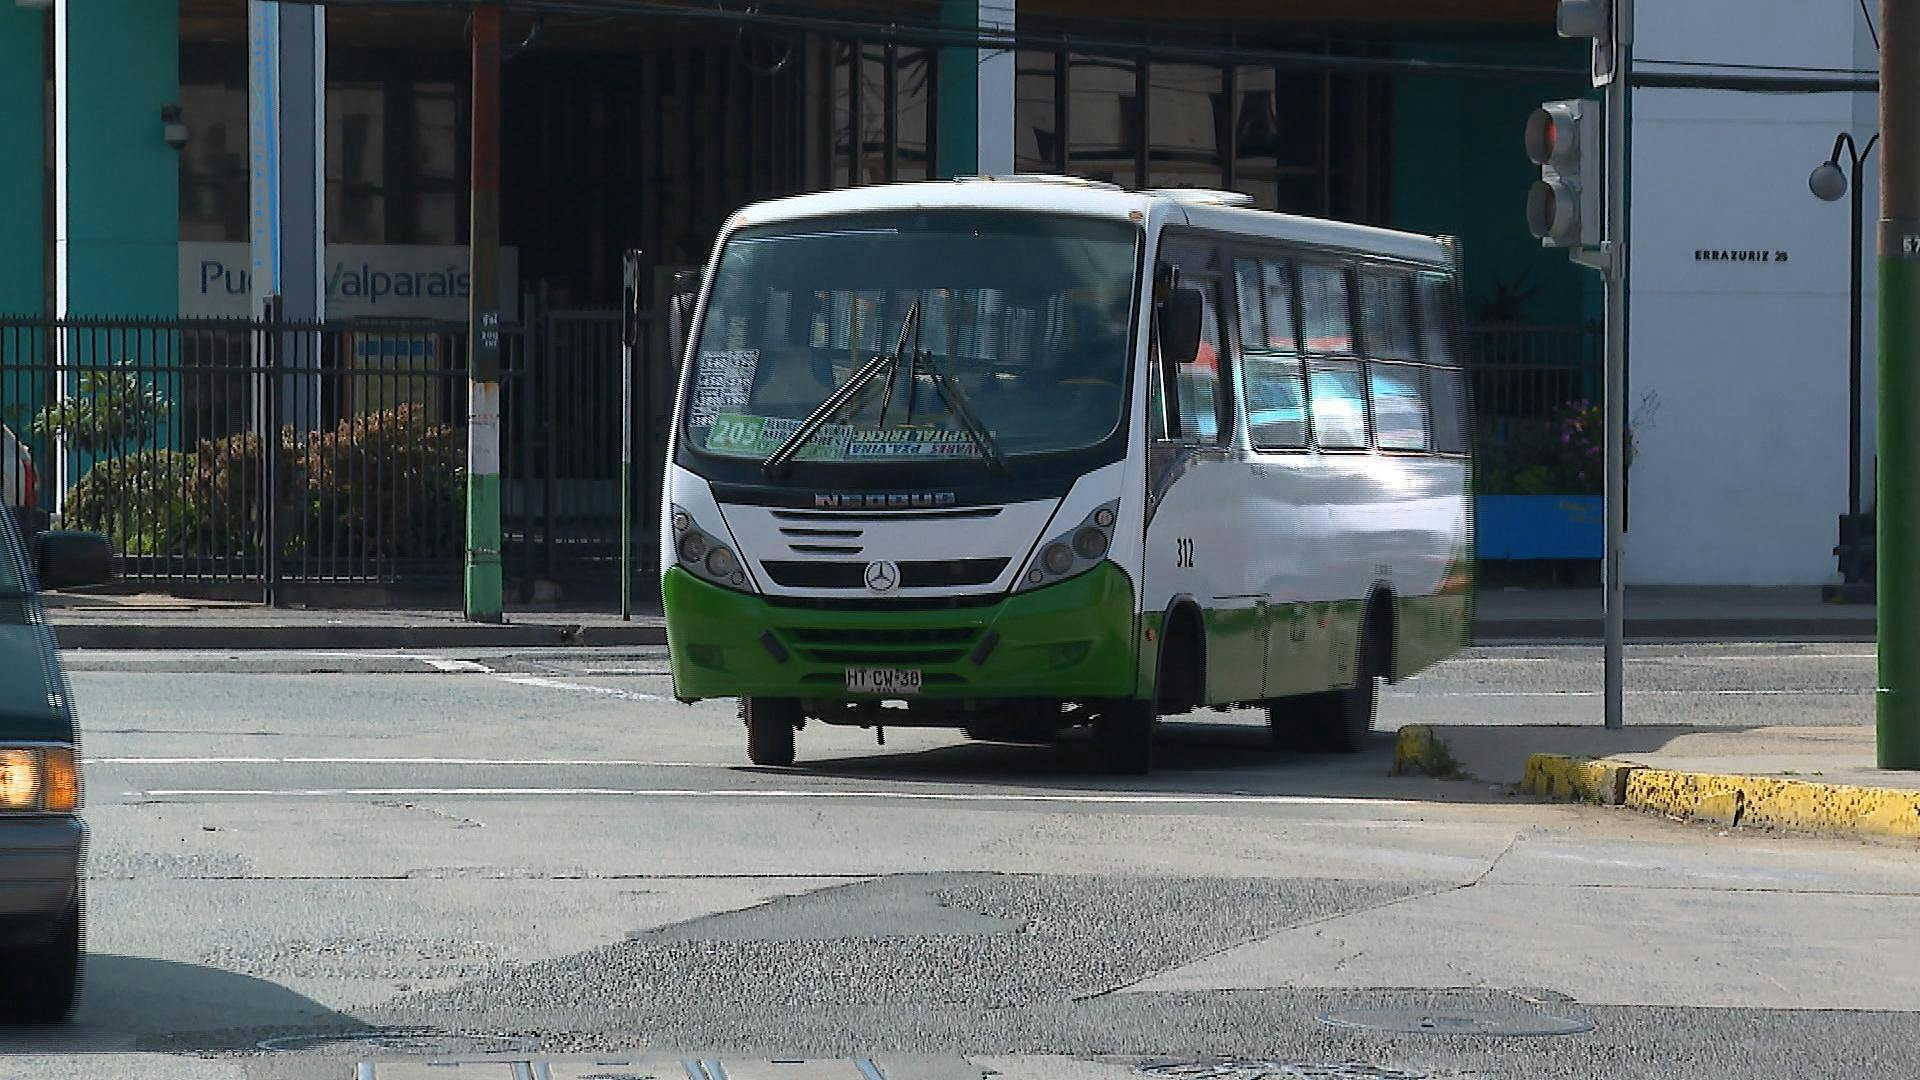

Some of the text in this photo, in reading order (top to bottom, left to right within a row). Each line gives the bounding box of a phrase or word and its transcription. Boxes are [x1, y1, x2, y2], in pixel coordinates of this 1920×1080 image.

[1694, 250, 1769, 261] ERRAZURIZ
[711, 420, 760, 445] 205
[1177, 538, 1194, 568] 312
